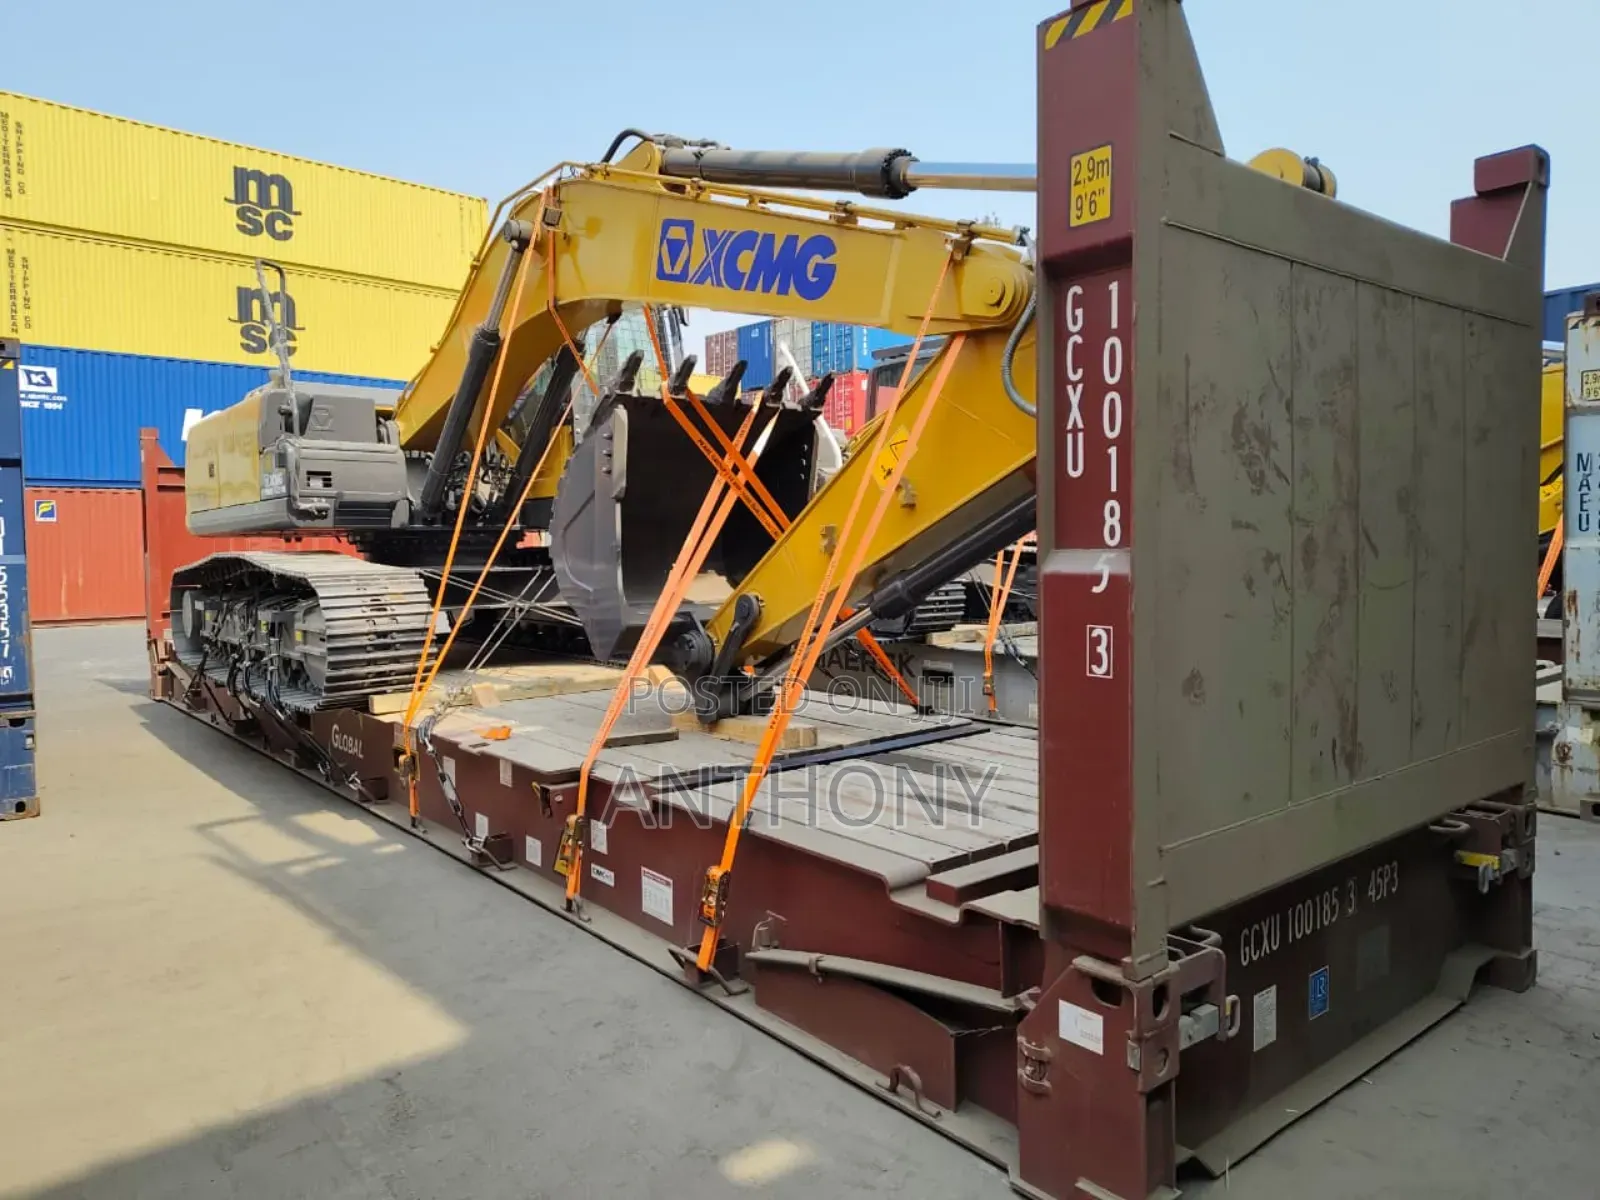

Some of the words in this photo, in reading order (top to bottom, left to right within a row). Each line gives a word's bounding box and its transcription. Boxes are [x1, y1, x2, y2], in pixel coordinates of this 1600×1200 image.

[15, 121, 25, 175] SHIPPING
[1073, 156, 1110, 188] 2,9m
[21, 256, 31, 310] SHIPPING
[689, 228, 837, 301] XCMG
[1066, 285, 1084, 478] GCXU
[1584, 373, 1600, 385] 2,9
[1091, 281, 1123, 594] 100185
[1576, 453, 1592, 532] MAEU
[1091, 628, 1108, 675] 3
[331, 723, 364, 759] GLOBAL
[1240, 913, 1280, 967] GCXU
[1288, 887, 1340, 944] 100185
[1368, 860, 1399, 903] 45P3
